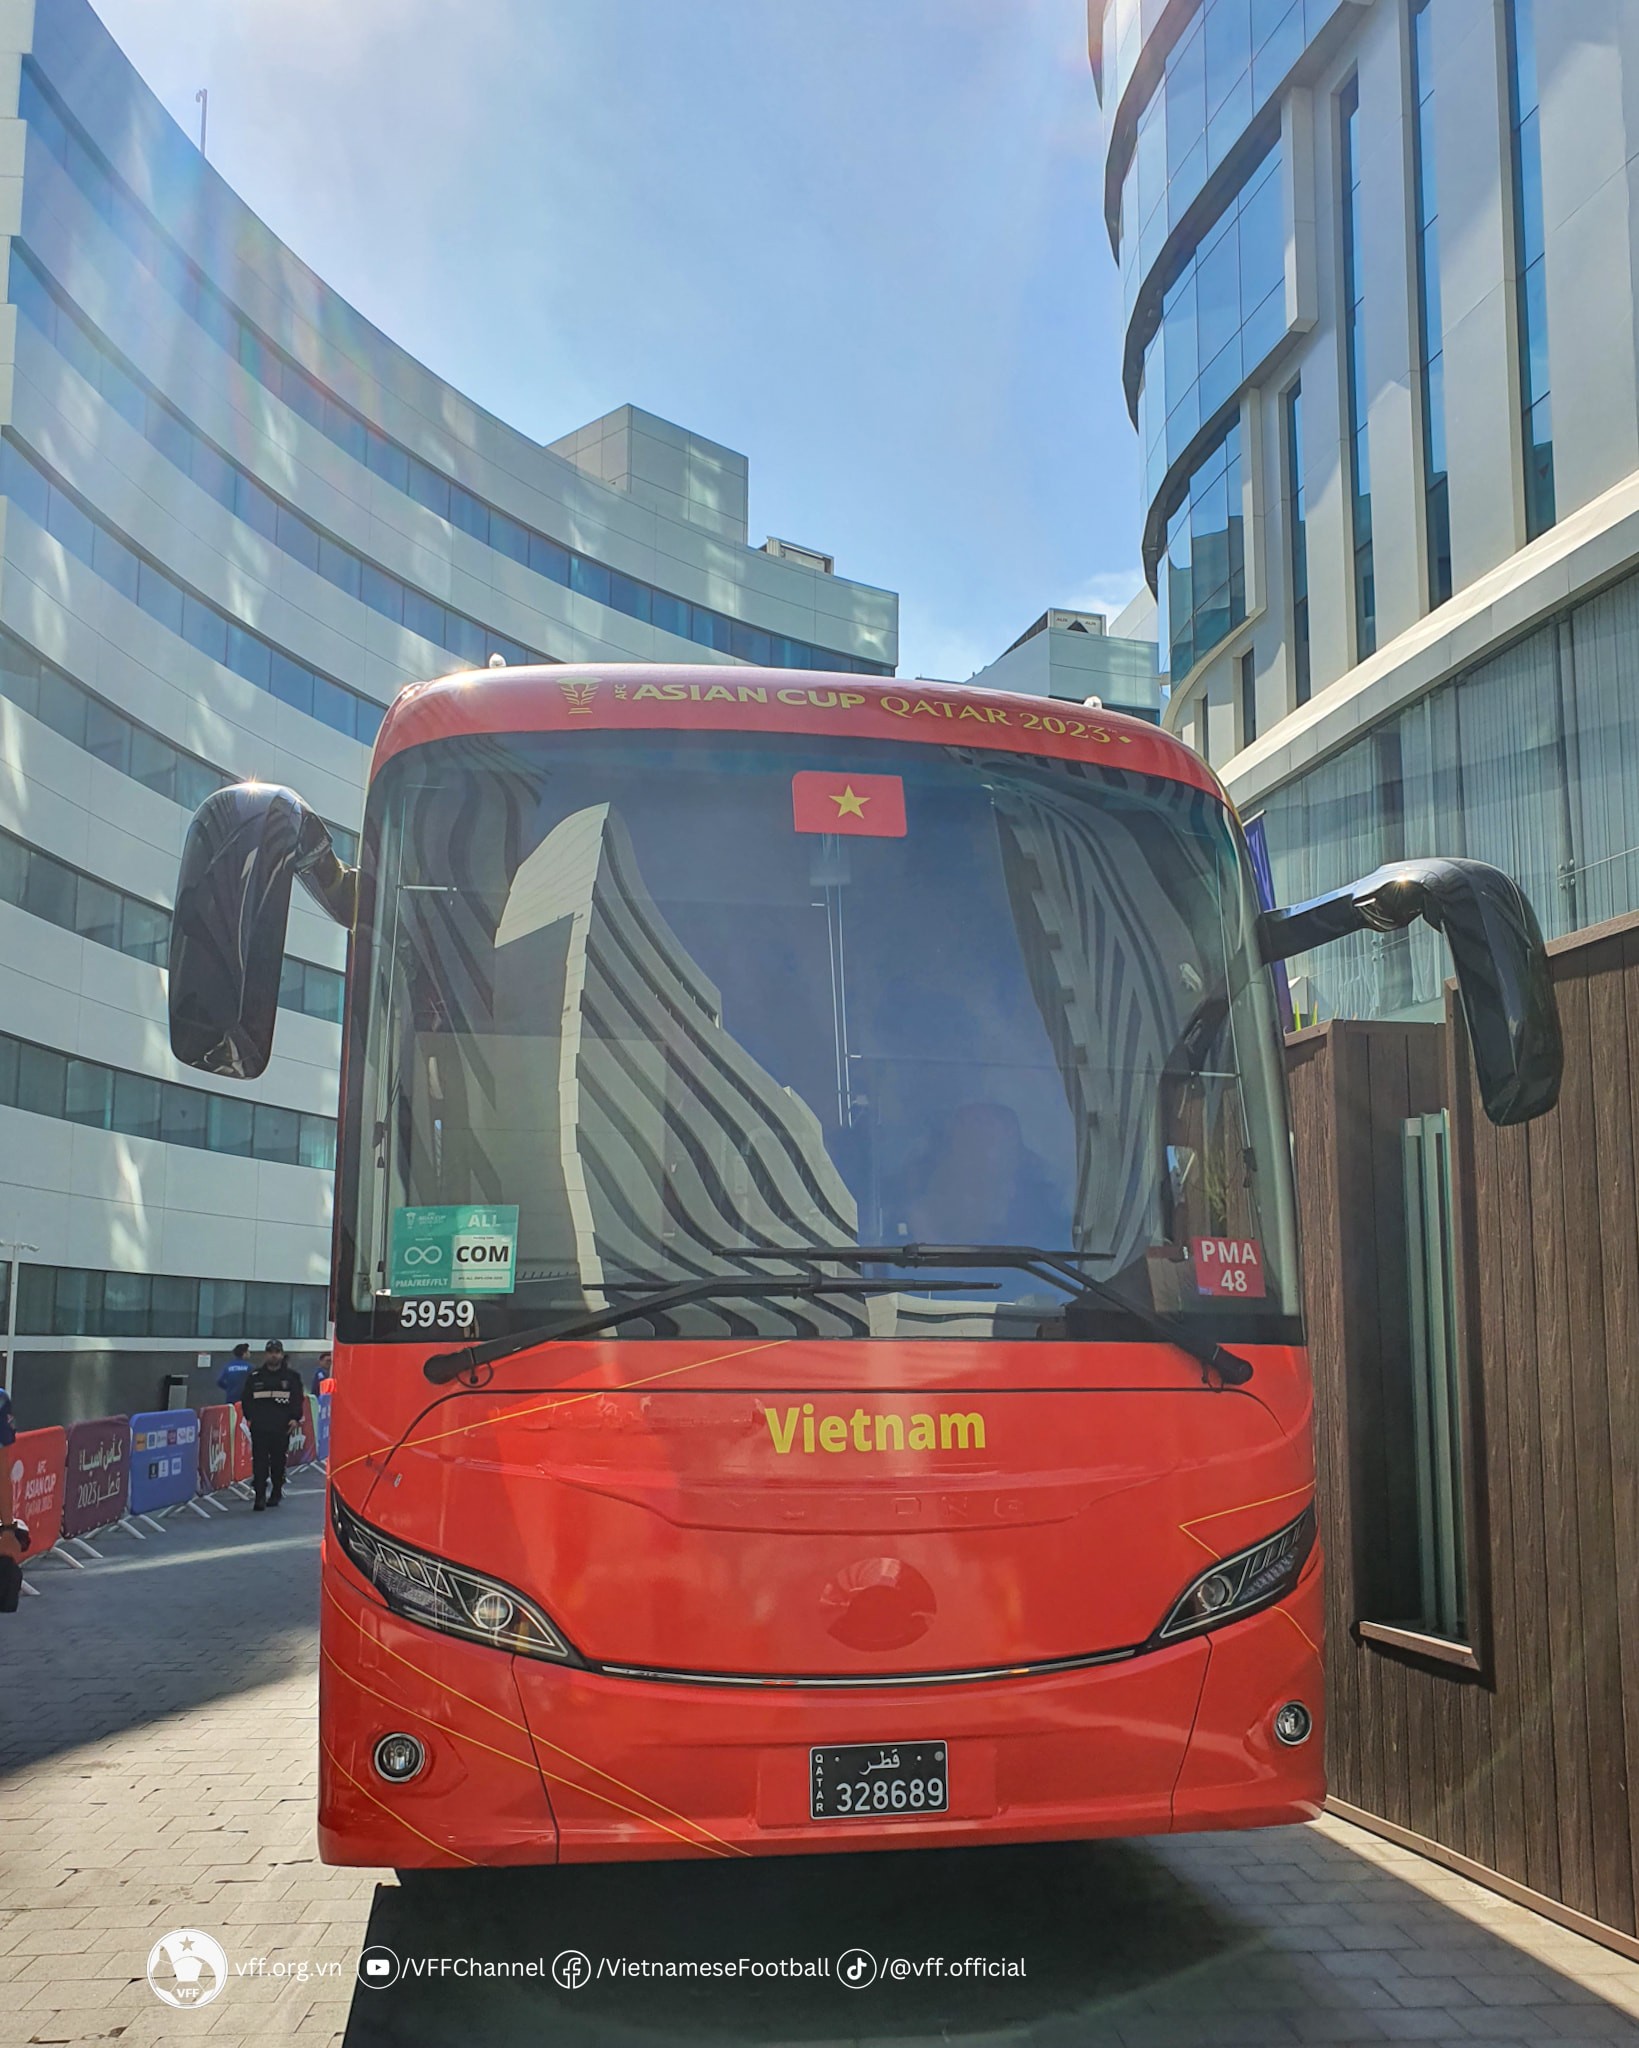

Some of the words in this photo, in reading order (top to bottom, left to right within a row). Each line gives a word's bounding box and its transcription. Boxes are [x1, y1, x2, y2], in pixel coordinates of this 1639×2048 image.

[614, 683, 627, 700] AFC
[632, 684, 768, 704] ASIAN
[776, 688, 866, 709] CUP
[880, 696, 1012, 726] QATAR
[1019, 712, 1111, 744] 2023
[468, 1214, 501, 1228] ALL
[456, 1245, 509, 1263] COM
[1201, 1240, 1258, 1265] PMA
[1221, 1269, 1248, 1292] 48
[400, 1300, 474, 1328] 5959
[764, 1404, 986, 1454] Vietnam
[25, 1477, 44, 1499] ASIAN
[44, 1473, 56, 1494] CUP
[78, 1482, 97, 1508] 2023
[859, 1748, 901, 1775] قطر
[815, 1754, 824, 1812] QATAR
[836, 1778, 944, 1812] 328689
